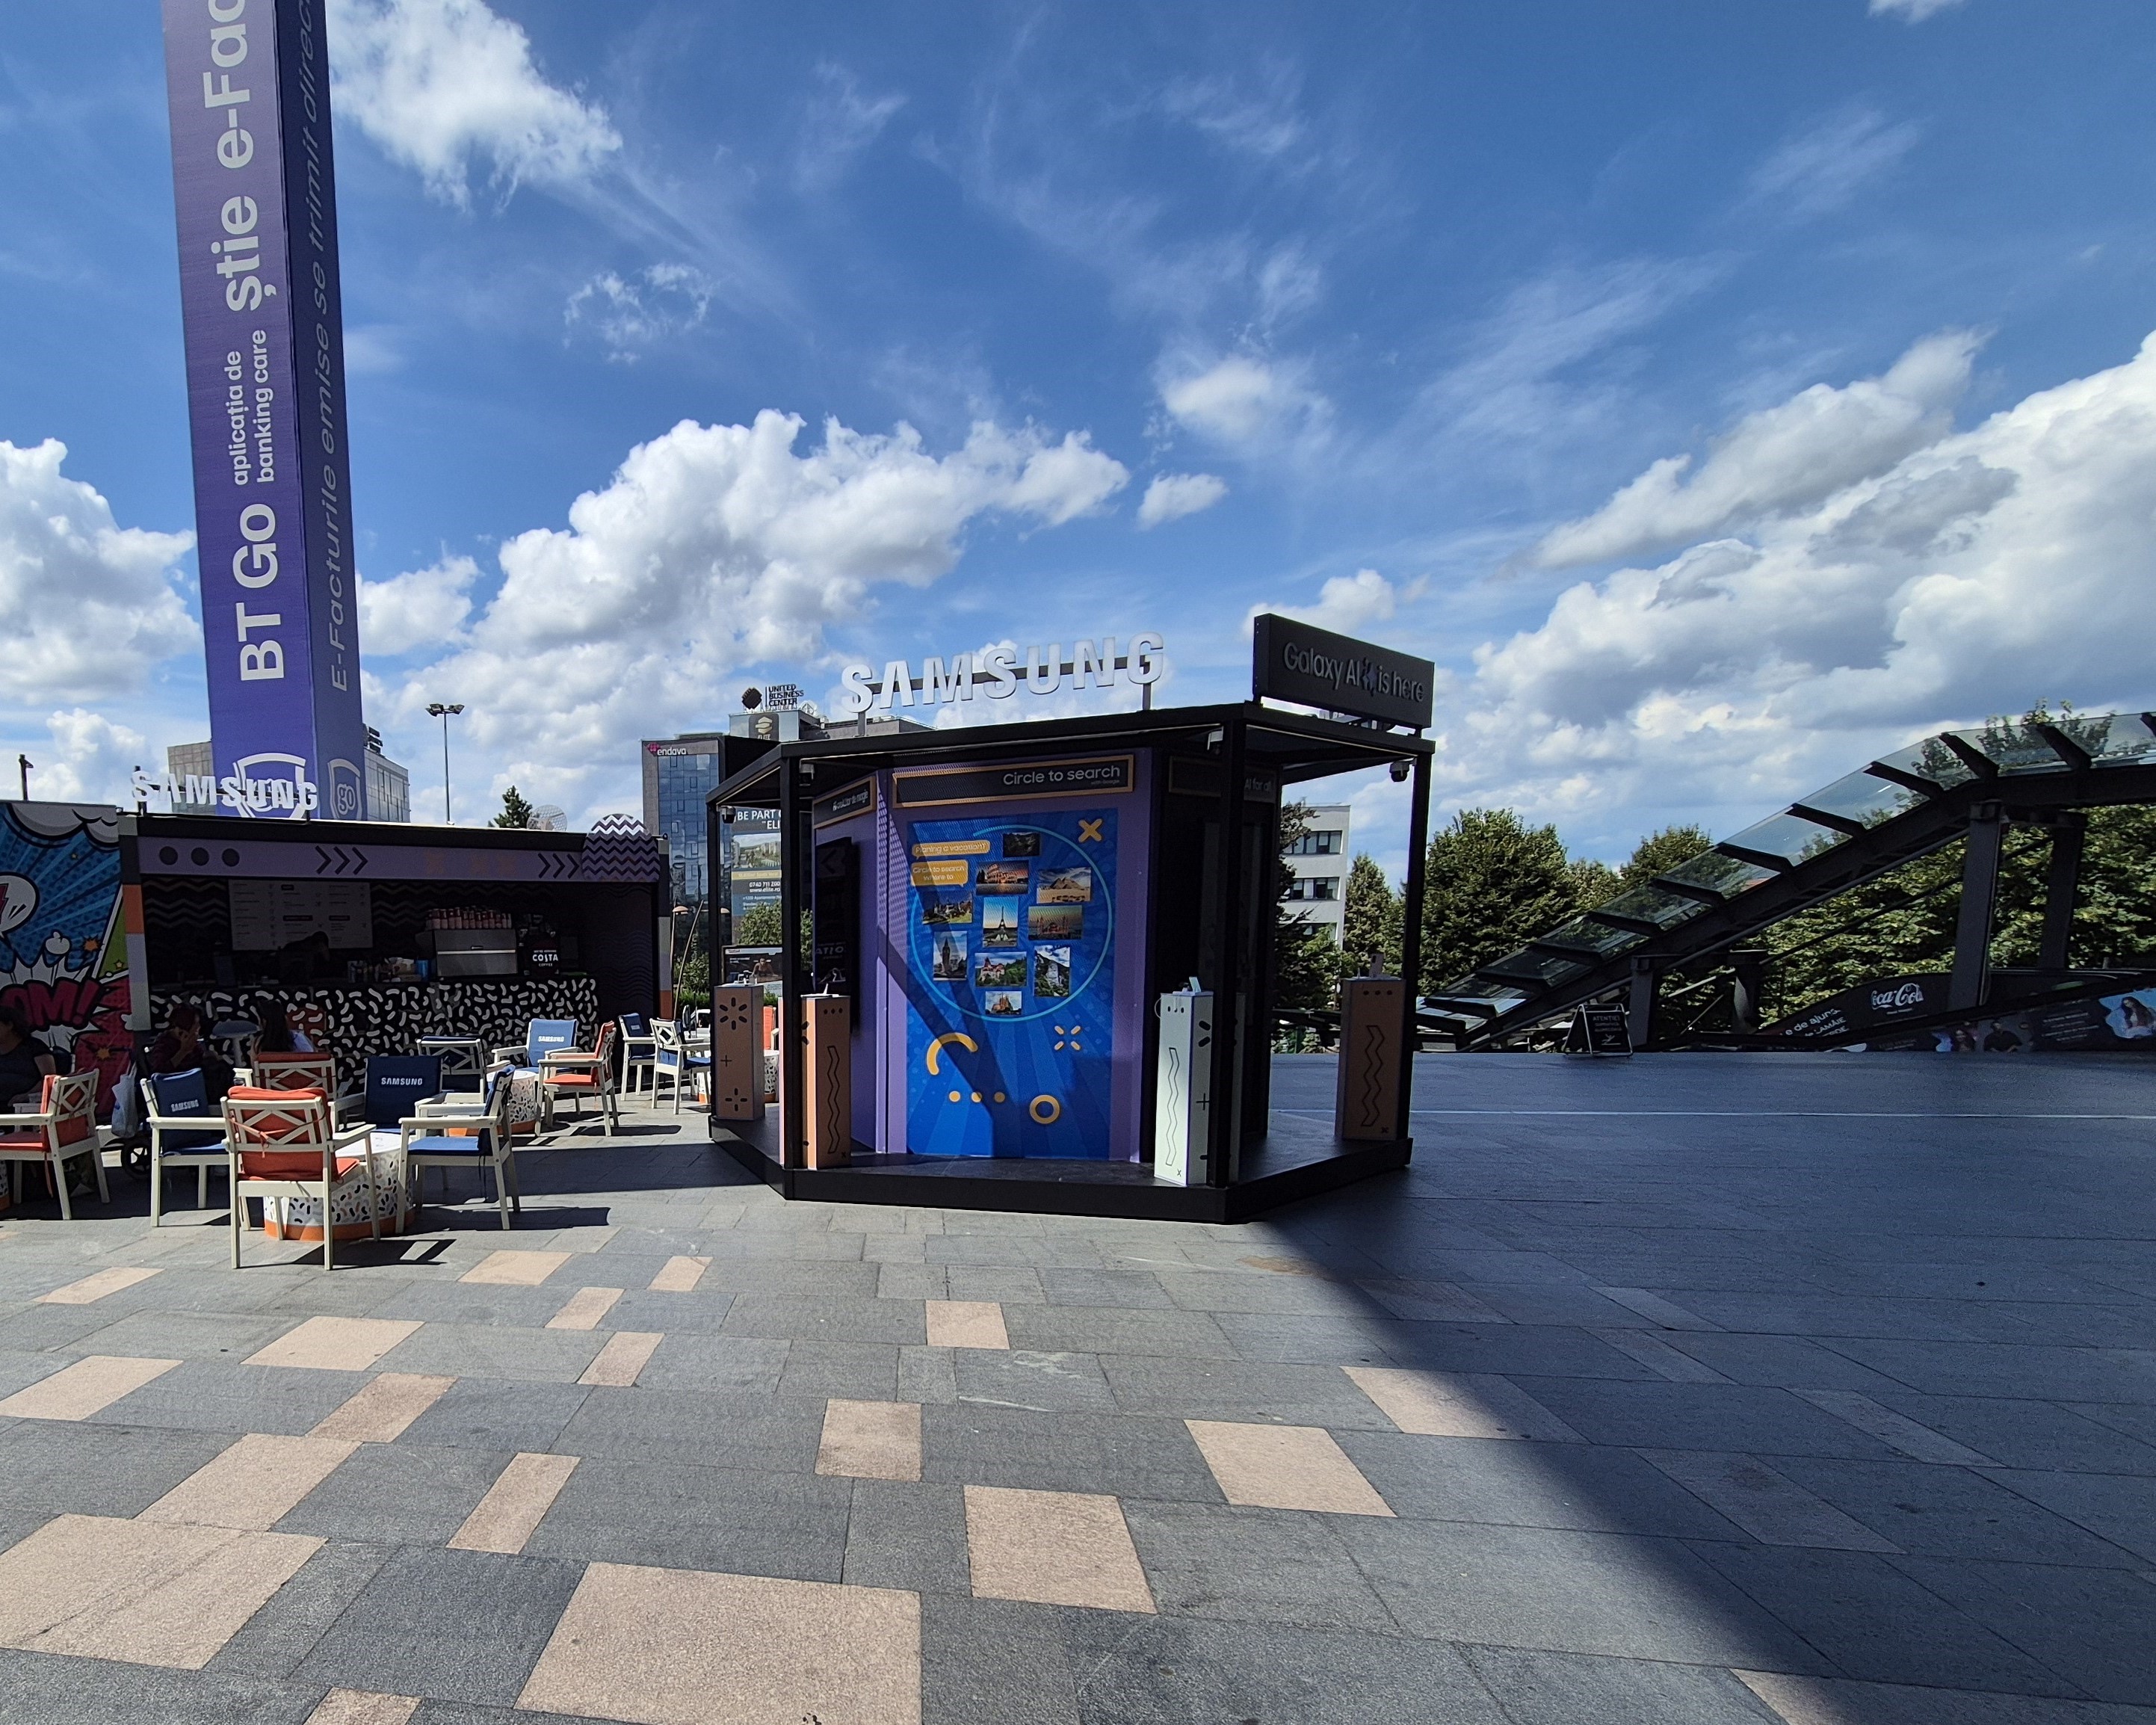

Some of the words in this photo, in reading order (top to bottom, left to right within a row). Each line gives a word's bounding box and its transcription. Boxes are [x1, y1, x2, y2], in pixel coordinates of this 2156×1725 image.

[298, 0, 318, 123] direc
[303, 126, 324, 252] trimit
[313, 261, 327, 315] se
[224, 351, 243, 380] de
[251, 330, 269, 383] care
[315, 322, 336, 454] emise
[225, 383, 252, 486] aplicația
[252, 387, 275, 483] banking
[321, 464, 348, 692] E-Facturile
[235, 602, 285, 681] BT
[768, 683, 797, 693] UNITED
[841, 630, 1164, 714] SAMSUNG
[1283, 641, 1344, 691] Galaxy
[1346, 658, 1360, 687] AI
[1378, 665, 1390, 694] is
[1392, 670, 1424, 703] here
[768, 697, 797, 706] CENTER
[769, 690, 804, 700] BUSINESS
[657, 747, 687, 756] endava
[130, 770, 318, 812] SAMSUNG
[1002, 770, 1045, 786] Circle
[1048, 768, 1063, 782] to
[1066, 765, 1121, 781] search
[337, 783, 356, 816] go
[737, 810, 749, 821] BE
[751, 809, 776, 820] PART
[531, 953, 558, 963] COSTA
[380, 1076, 423, 1086] SAMSUNG
[170, 1098, 200, 1113] SAMSUNG
